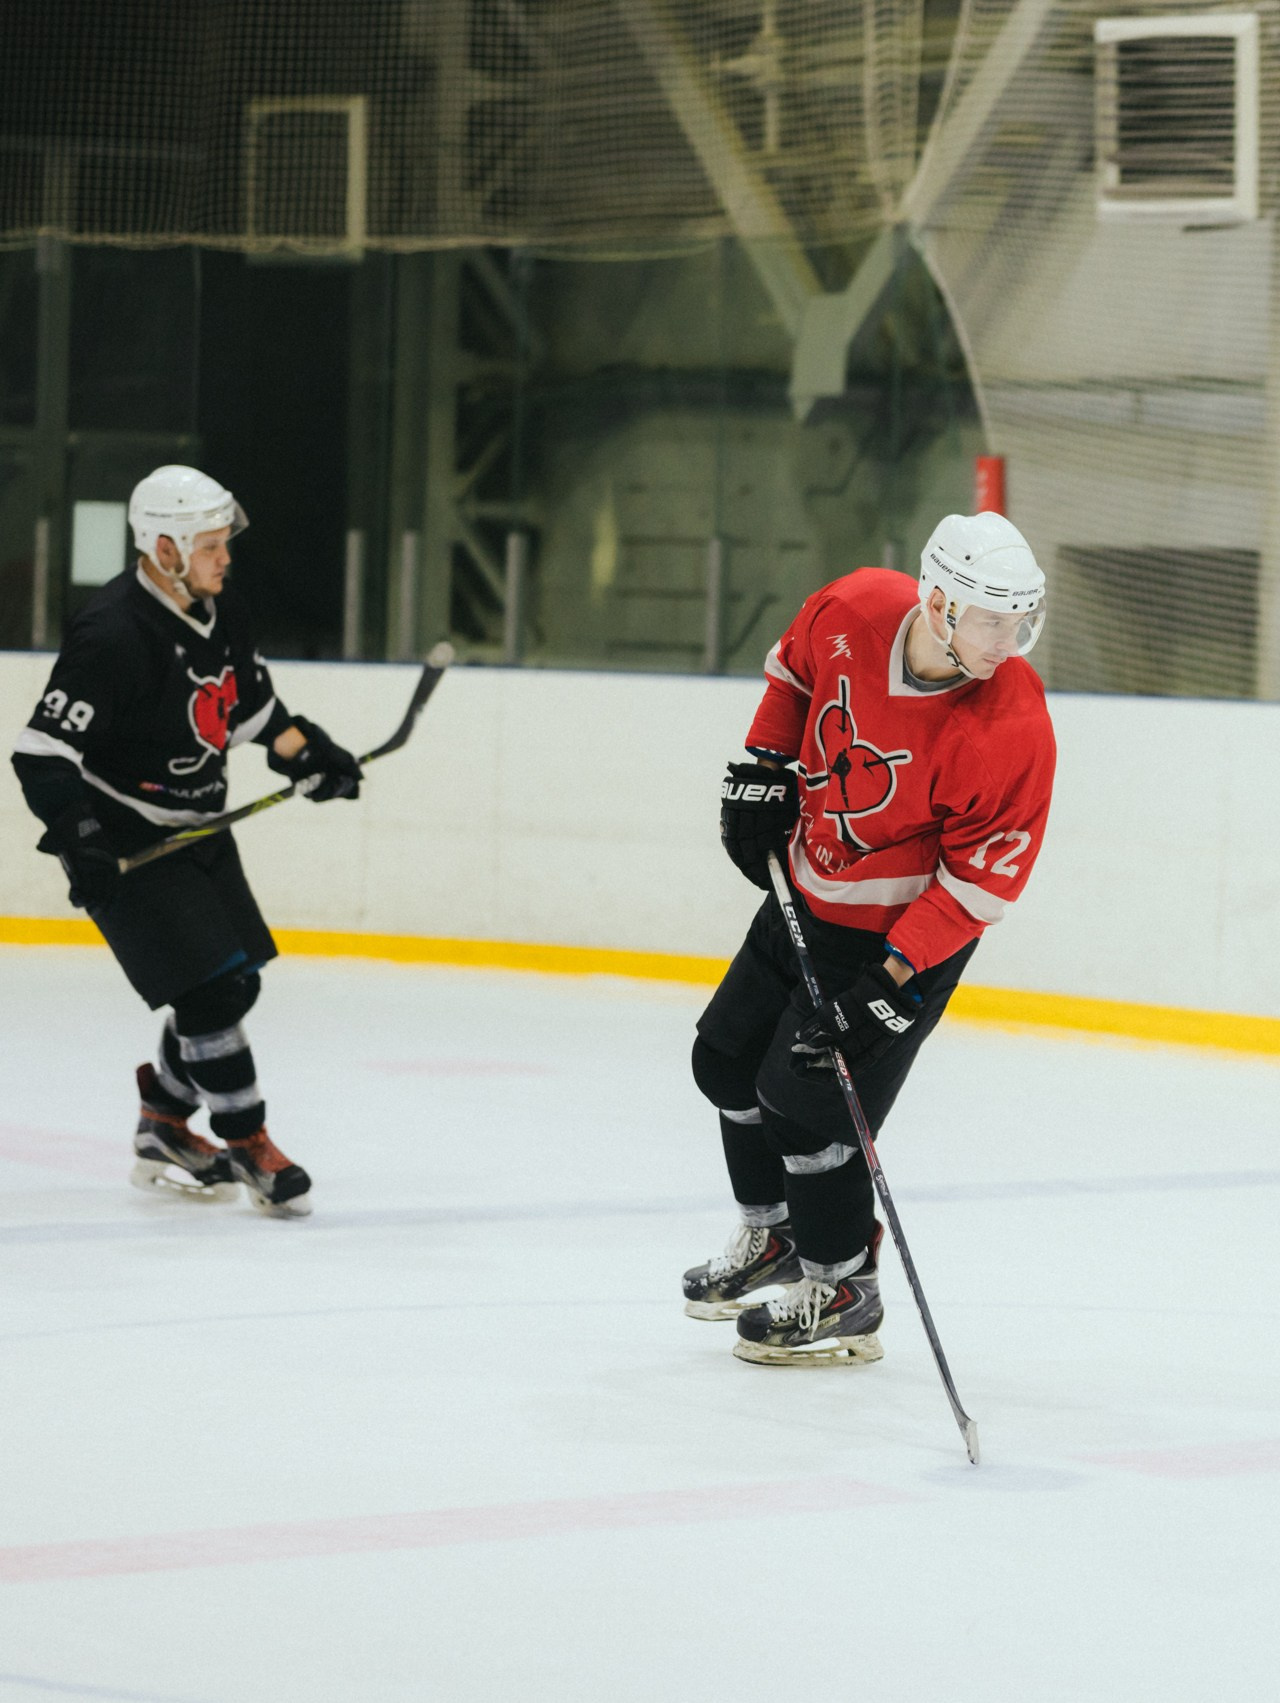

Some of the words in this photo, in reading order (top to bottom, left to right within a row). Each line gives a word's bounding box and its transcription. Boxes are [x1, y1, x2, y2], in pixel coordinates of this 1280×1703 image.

[721, 782, 787, 802] AUER
[969, 830, 1032, 878] 12
[785, 906, 806, 948] CCM
[834, 1002, 850, 1029] NEXUS
